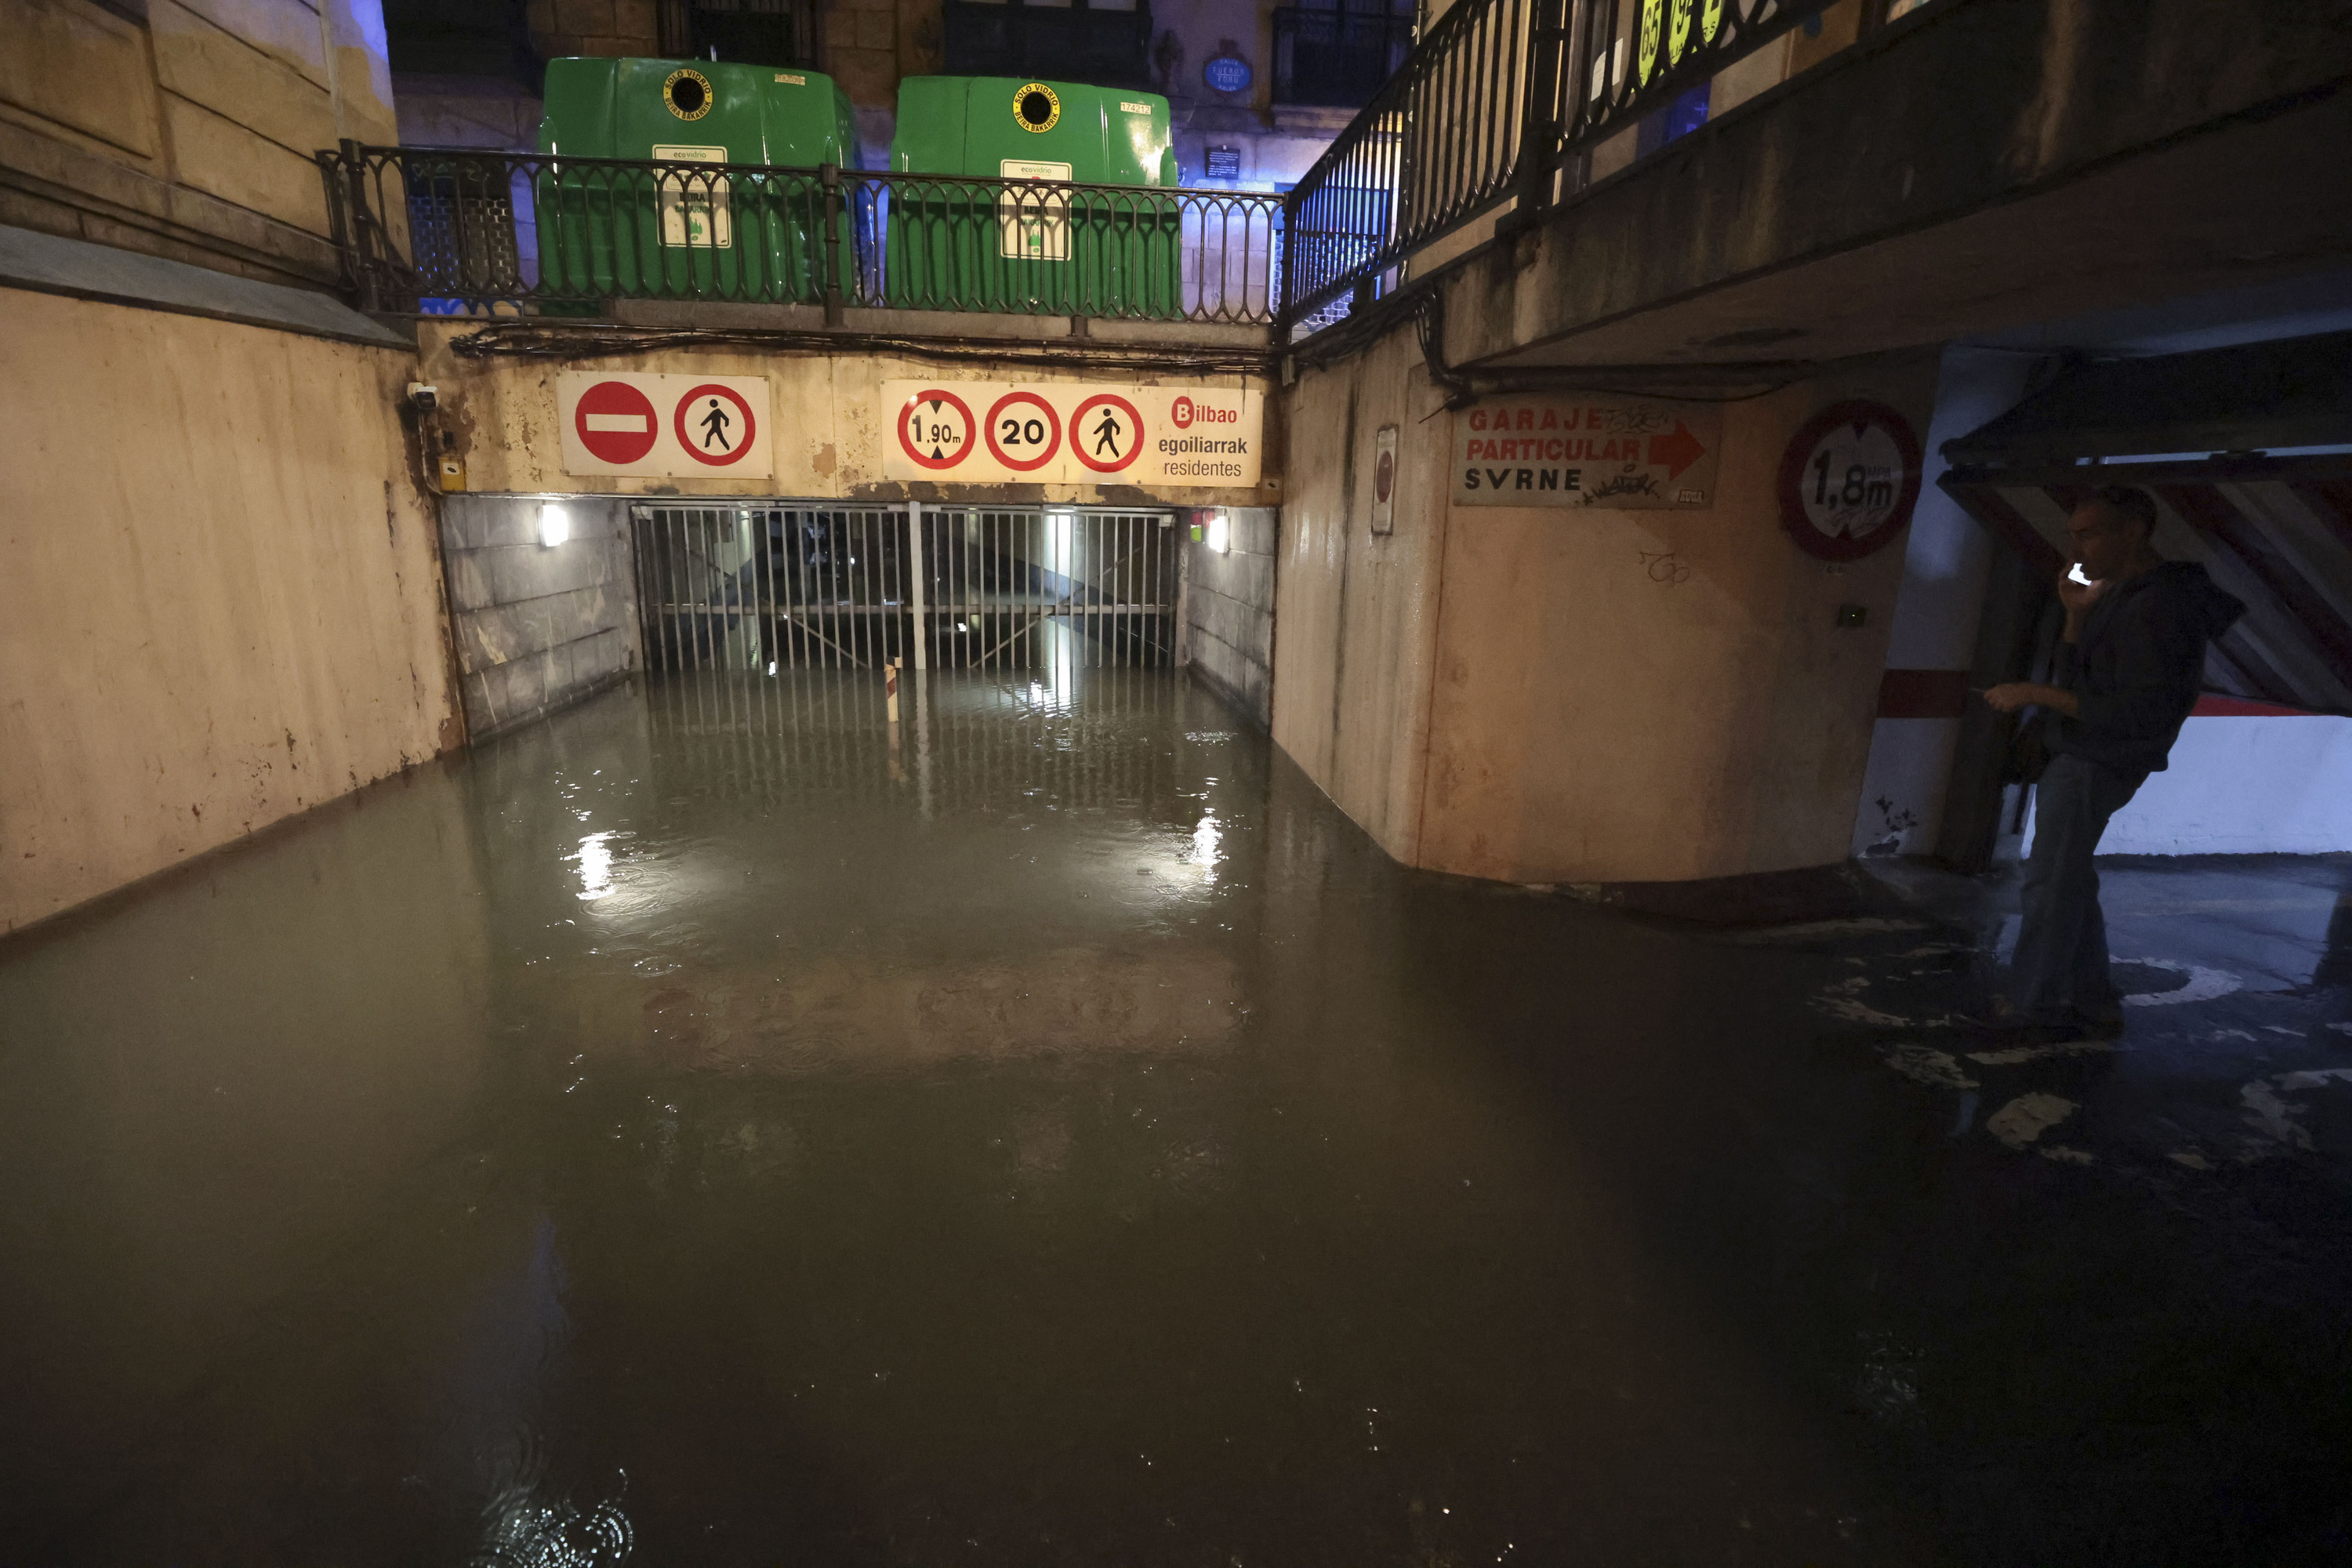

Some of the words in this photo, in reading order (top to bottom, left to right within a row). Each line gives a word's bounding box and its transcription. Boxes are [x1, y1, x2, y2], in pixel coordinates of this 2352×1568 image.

[666, 71, 683, 89] SOLO
[687, 70, 711, 93] VIDRIO
[1213, 67, 1244, 75] FUEROS
[1218, 75, 1238, 84] FORU
[1015, 85, 1032, 103] SOLO
[1035, 85, 1058, 106] VIDRIO
[666, 97, 681, 116] BEIRA
[682, 100, 711, 120] BAKARRIK
[1121, 103, 1150, 114] 174212
[1015, 111, 1029, 129] BEIRA
[1031, 113, 1058, 132] BAKARRIK
[1175, 403, 1237, 423] Bilbao
[1469, 408, 1603, 431] GARAJE
[1002, 419, 1045, 445] 20
[1159, 436, 1248, 456] egoiliarrak
[1466, 438, 1641, 461] PARTICULAR
[1164, 459, 1242, 477] residentes
[1465, 468, 1582, 490] SVRNE
